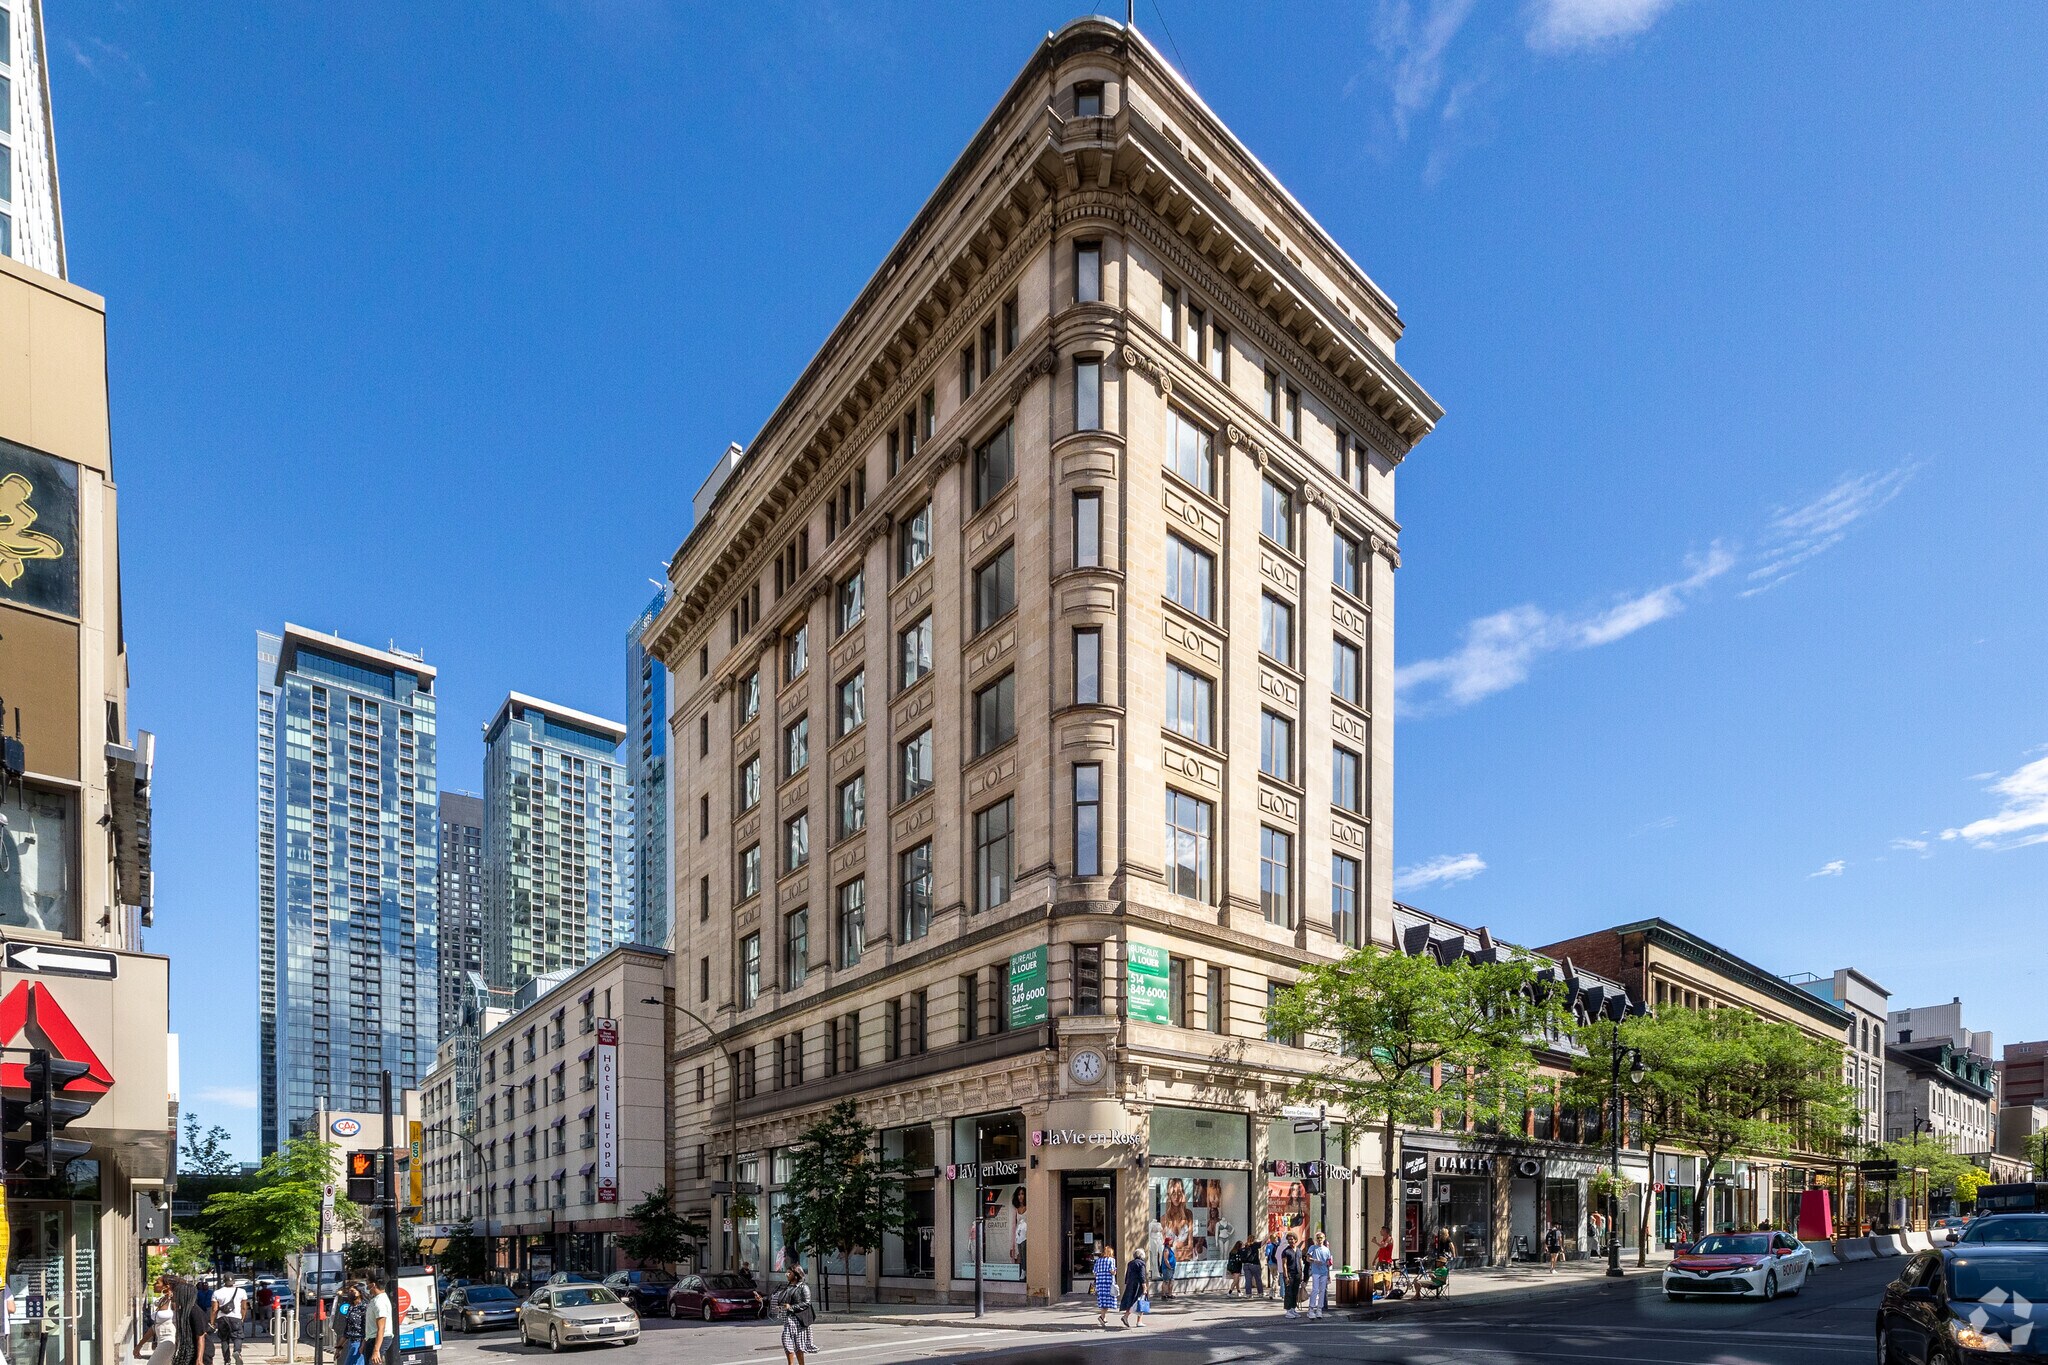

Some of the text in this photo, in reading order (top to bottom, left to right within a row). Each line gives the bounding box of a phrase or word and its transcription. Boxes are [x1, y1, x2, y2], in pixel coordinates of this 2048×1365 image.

[1012, 950, 1037, 966] BUREAUX
[1131, 944, 1159, 958] BUREAUX
[1011, 960, 1038, 976] À LOUER
[1131, 953, 1160, 968] À LOUER
[1130, 974, 1144, 985] 514
[1011, 982, 1024, 995] 514
[1012, 986, 1046, 1006] 849 6000
[1130, 985, 1167, 1000] 849 6000
[603, 1054, 611, 1101] Hôtel
[338, 1121, 357, 1132] CAA
[1060, 1130, 1086, 1145] Vie
[1088, 1132, 1106, 1145] en
[1111, 1129, 1141, 1146] Rose
[983, 1164, 994, 1177] en
[995, 1160, 1019, 1176] Rose
[1439, 1156, 1494, 1171] OAKLEY
[1329, 1163, 1352, 1180] Rose
